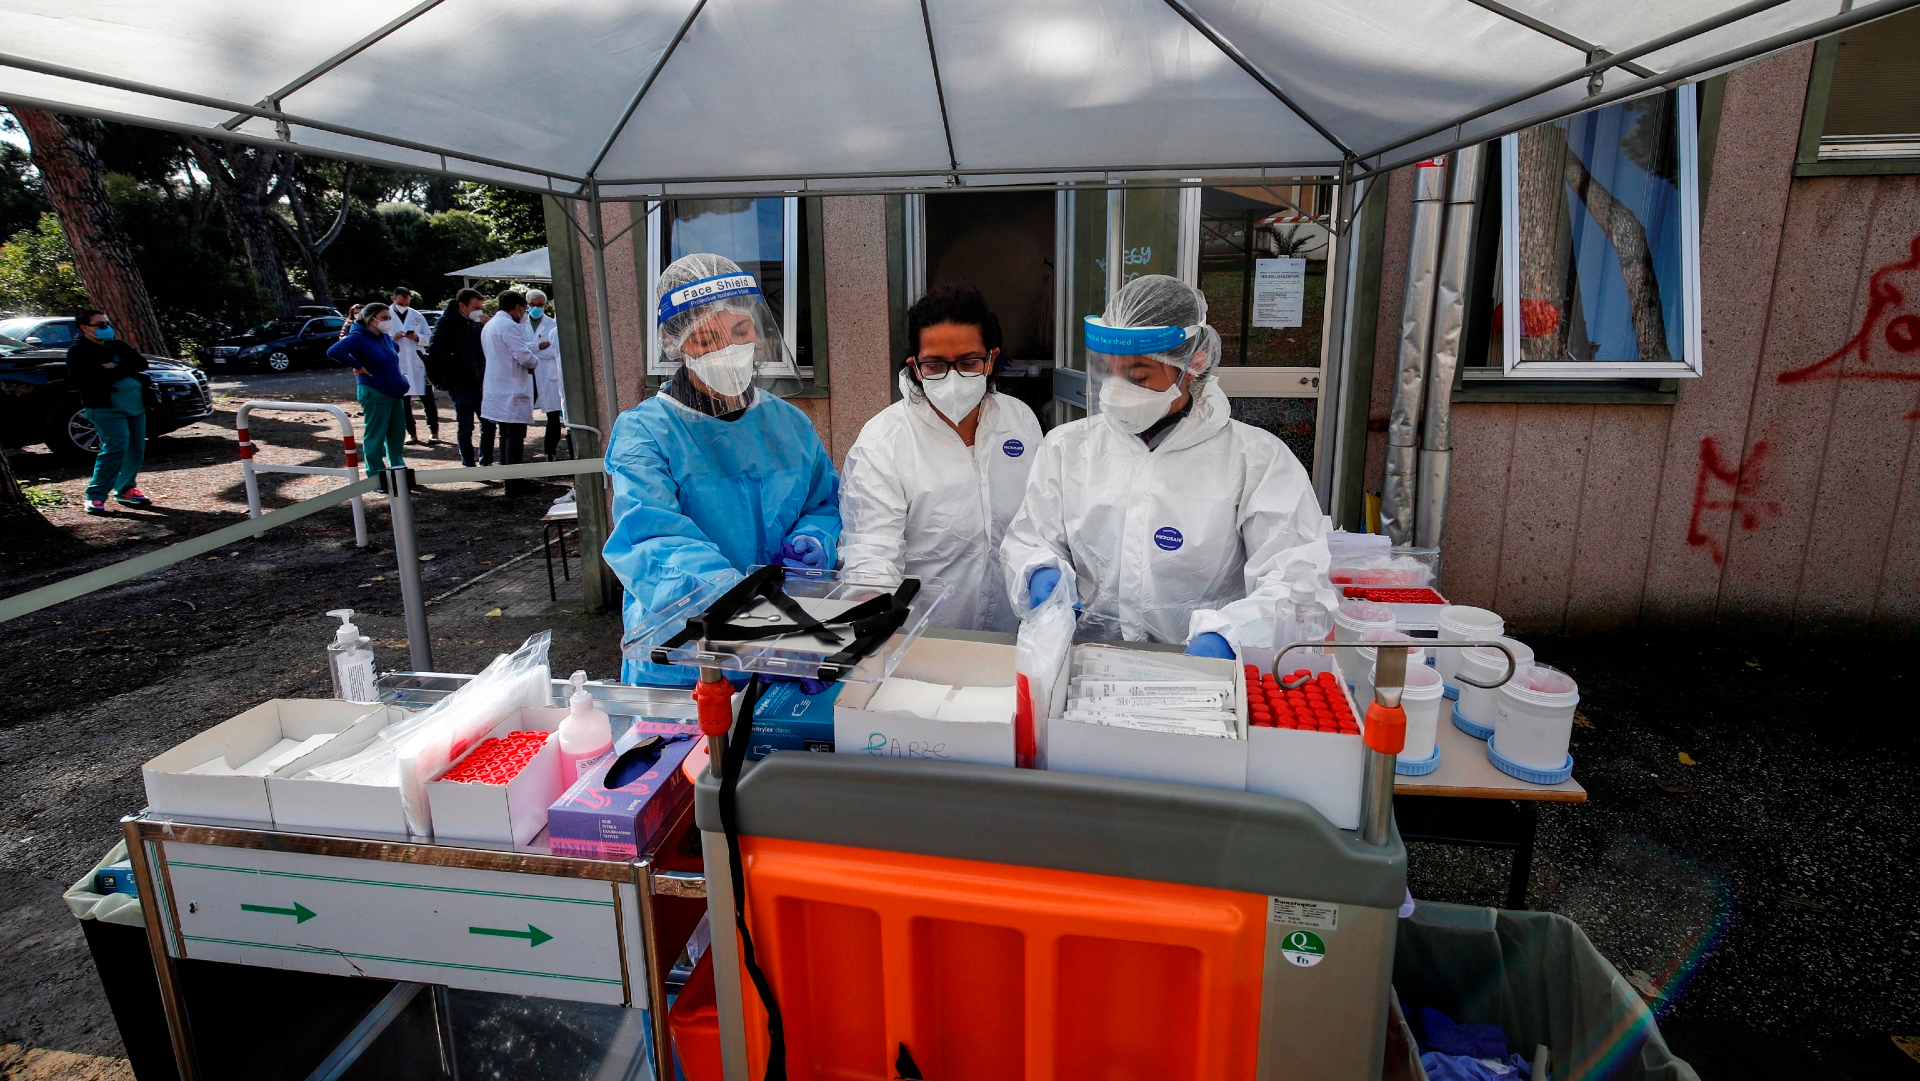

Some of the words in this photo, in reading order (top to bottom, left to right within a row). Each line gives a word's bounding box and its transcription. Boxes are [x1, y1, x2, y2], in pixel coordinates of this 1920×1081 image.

[683, 286, 712, 300] Face
[716, 278, 749, 291] Shield
[690, 294, 717, 306] Protective
[717, 289, 738, 300] Isolation
[1100, 336, 1112, 344] face
[1113, 338, 1132, 346] shield
